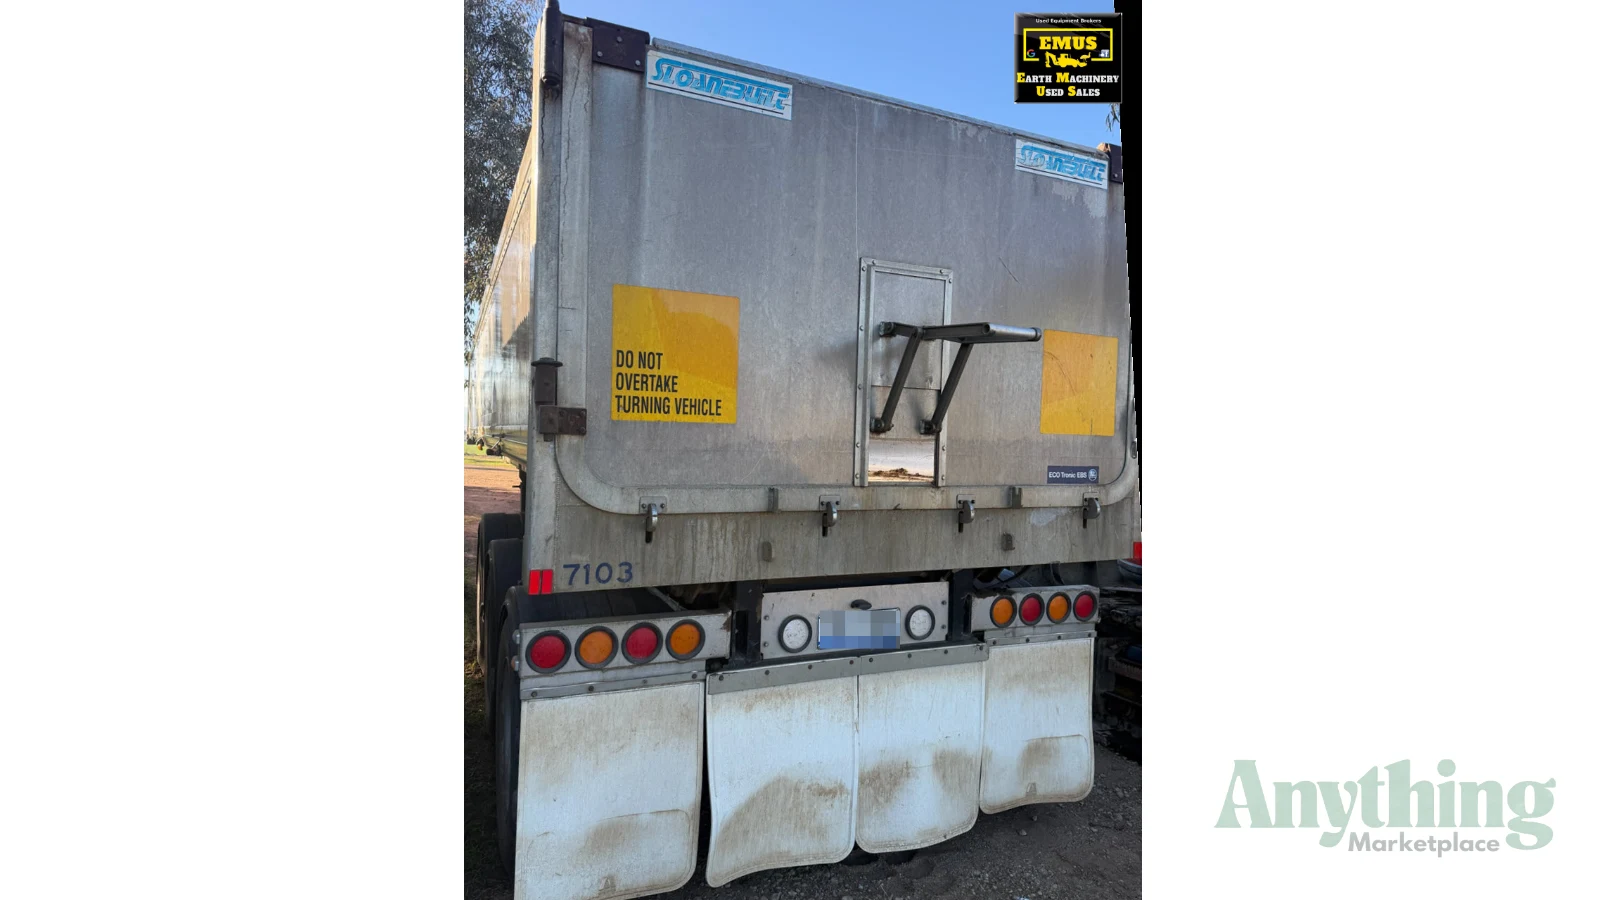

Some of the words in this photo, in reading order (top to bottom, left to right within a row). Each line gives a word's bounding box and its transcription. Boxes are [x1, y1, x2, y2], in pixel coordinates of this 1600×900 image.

[616, 349, 634, 368] DO
[638, 351, 663, 370] NOT
[615, 372, 678, 392] OVERTAKE
[615, 395, 671, 414] TURNING
[674, 398, 722, 416] VEHICLE
[563, 561, 633, 585] 7103
